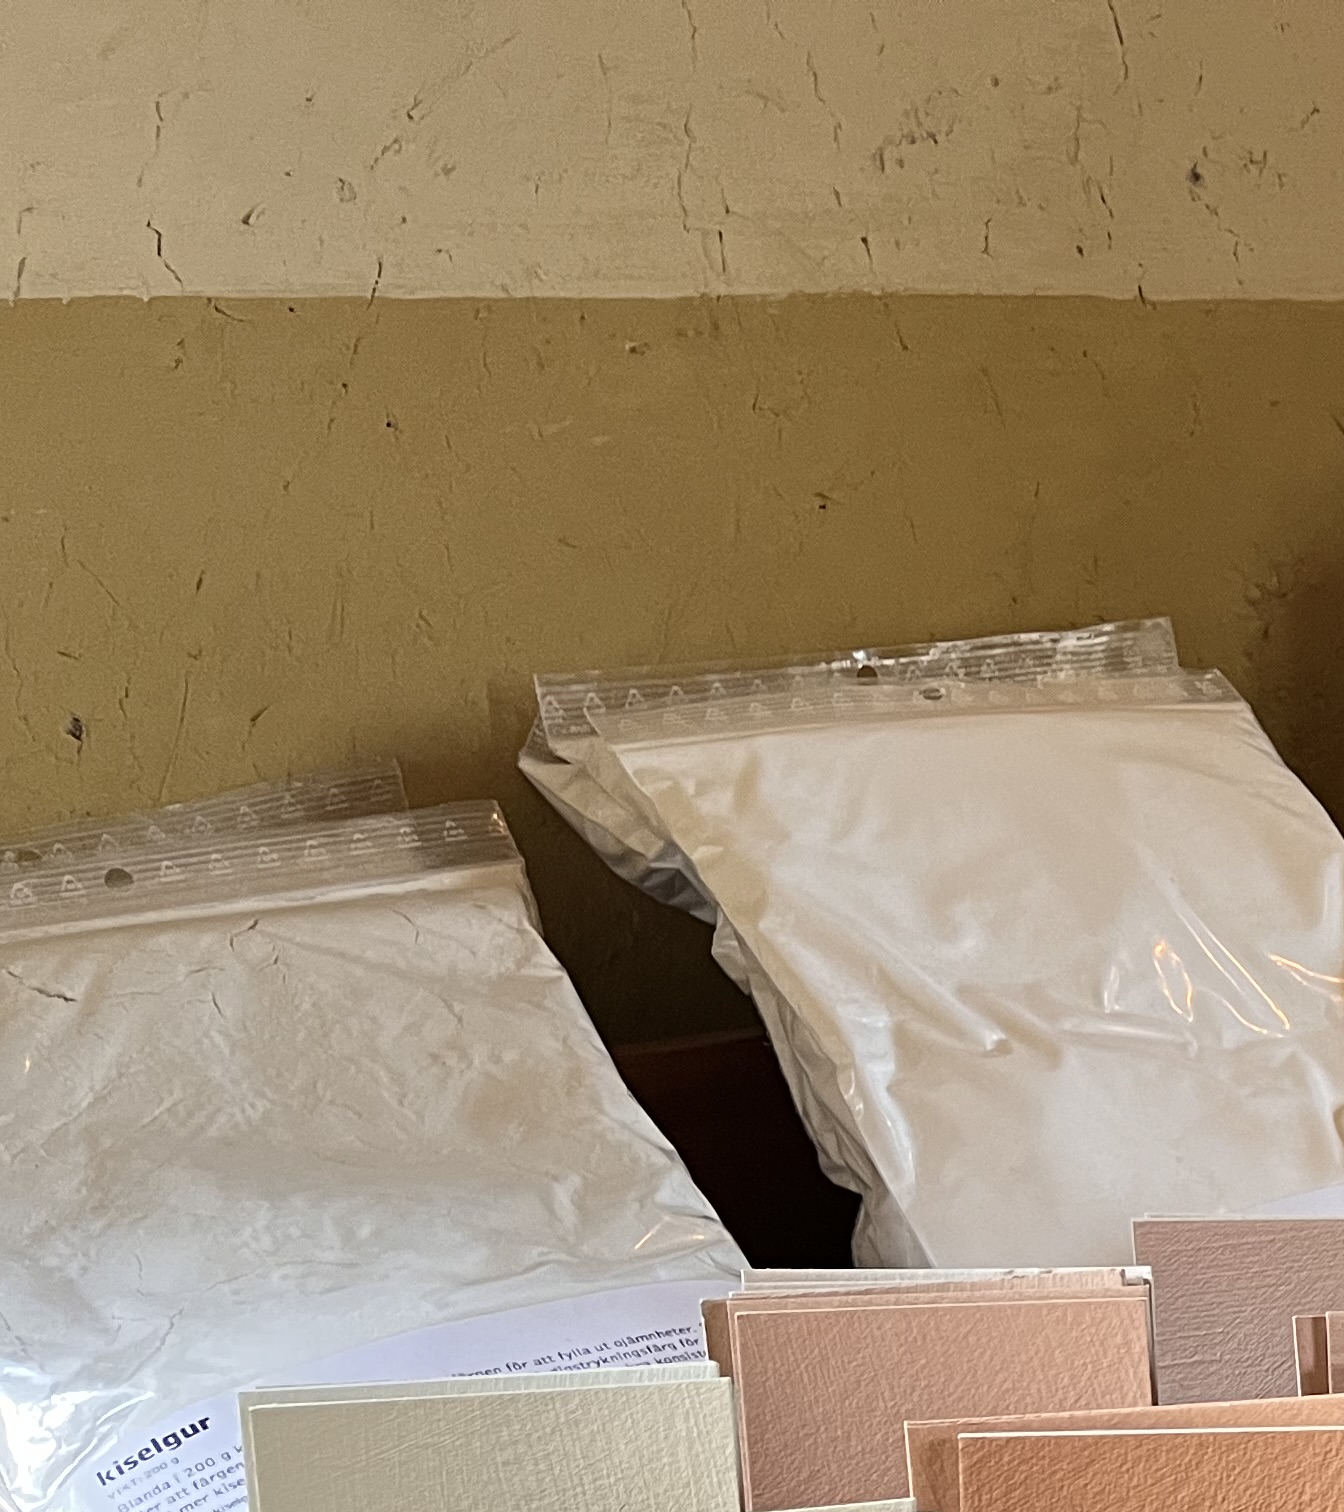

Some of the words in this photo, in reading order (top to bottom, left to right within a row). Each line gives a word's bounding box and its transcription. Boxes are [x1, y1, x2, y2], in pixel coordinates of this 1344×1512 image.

[679, 1337, 700, 1350] för
[505, 1360, 528, 1373] för
[533, 1354, 556, 1366] att
[558, 1346, 591, 1363] fylla
[594, 1341, 610, 1353] ut
[96, 1417, 210, 1486] kiselgur
[184, 1457, 215, 1478] 200
[221, 1452, 231, 1462] g
[167, 1487, 190, 1505] att
